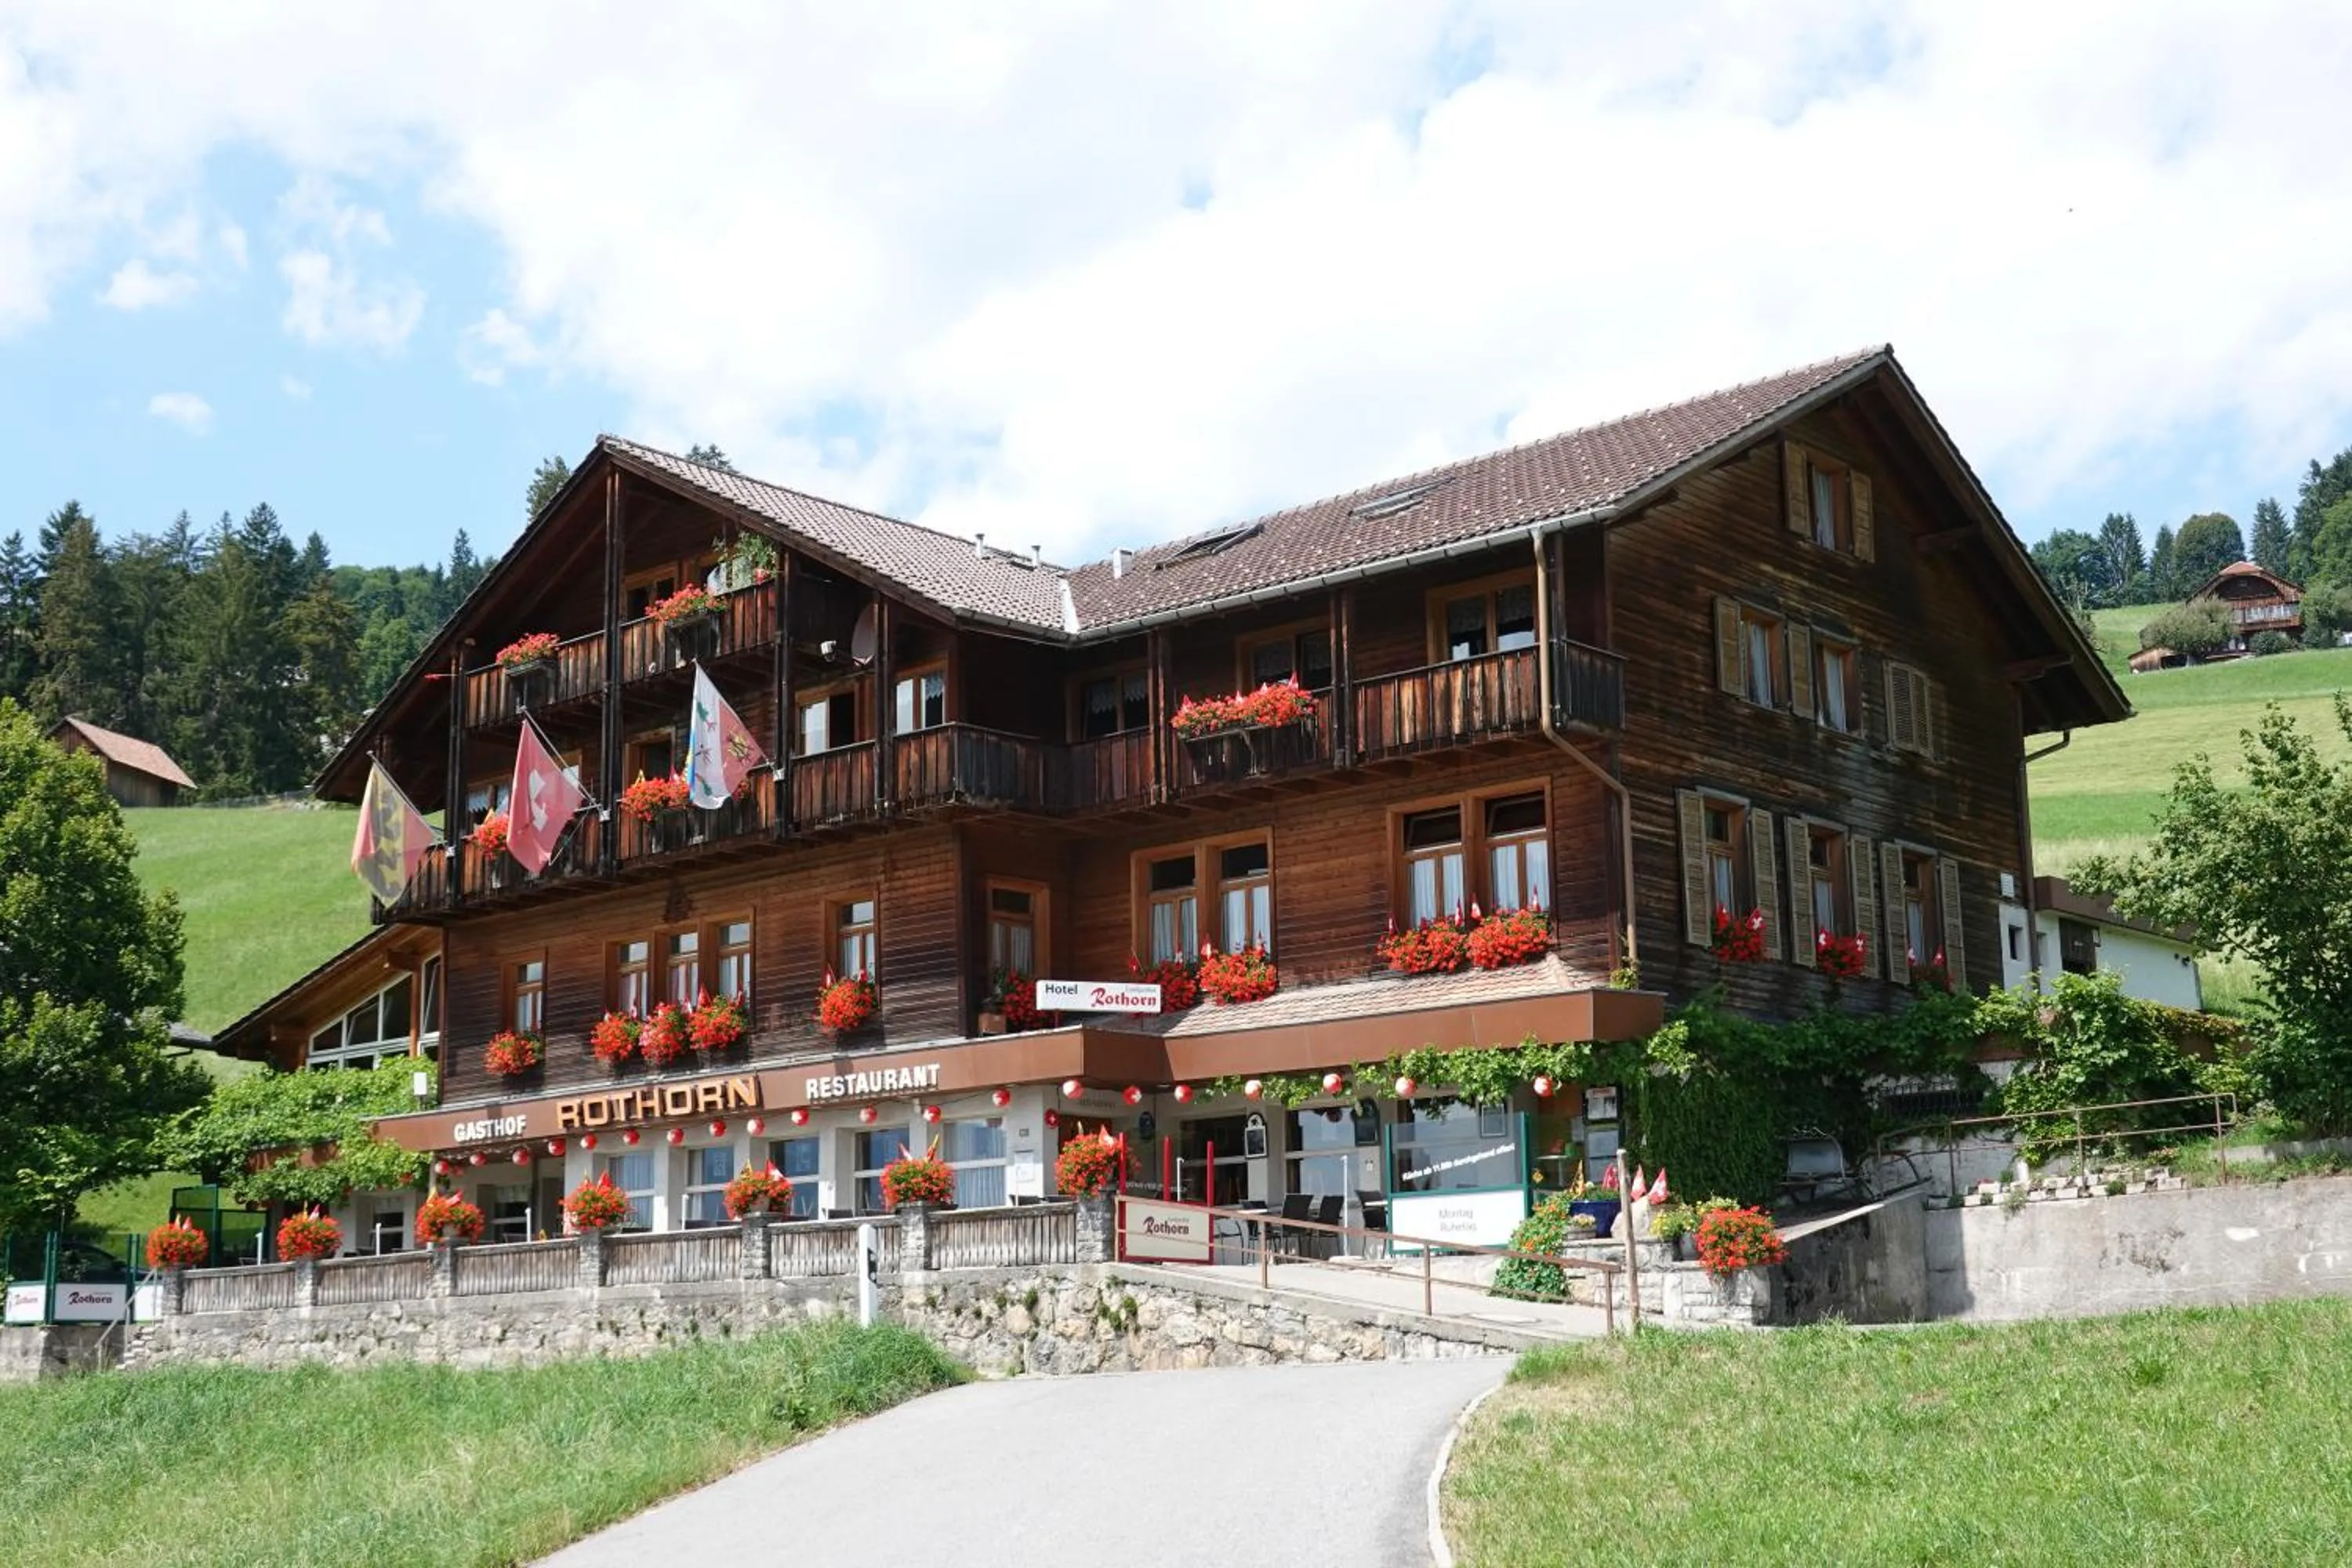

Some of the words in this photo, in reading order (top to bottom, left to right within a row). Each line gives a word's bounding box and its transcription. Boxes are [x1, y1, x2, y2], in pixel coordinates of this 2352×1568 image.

[1045, 983, 1078, 995] Hotel
[1091, 987, 1156, 1007] Rothorn
[453, 1114, 527, 1142] GASTHOF
[556, 1076, 758, 1130] ROTHORN
[806, 1063, 940, 1101] RESTAURANT
[1143, 1216, 1189, 1236] Rothorn
[68, 1291, 113, 1305] Rothorn
